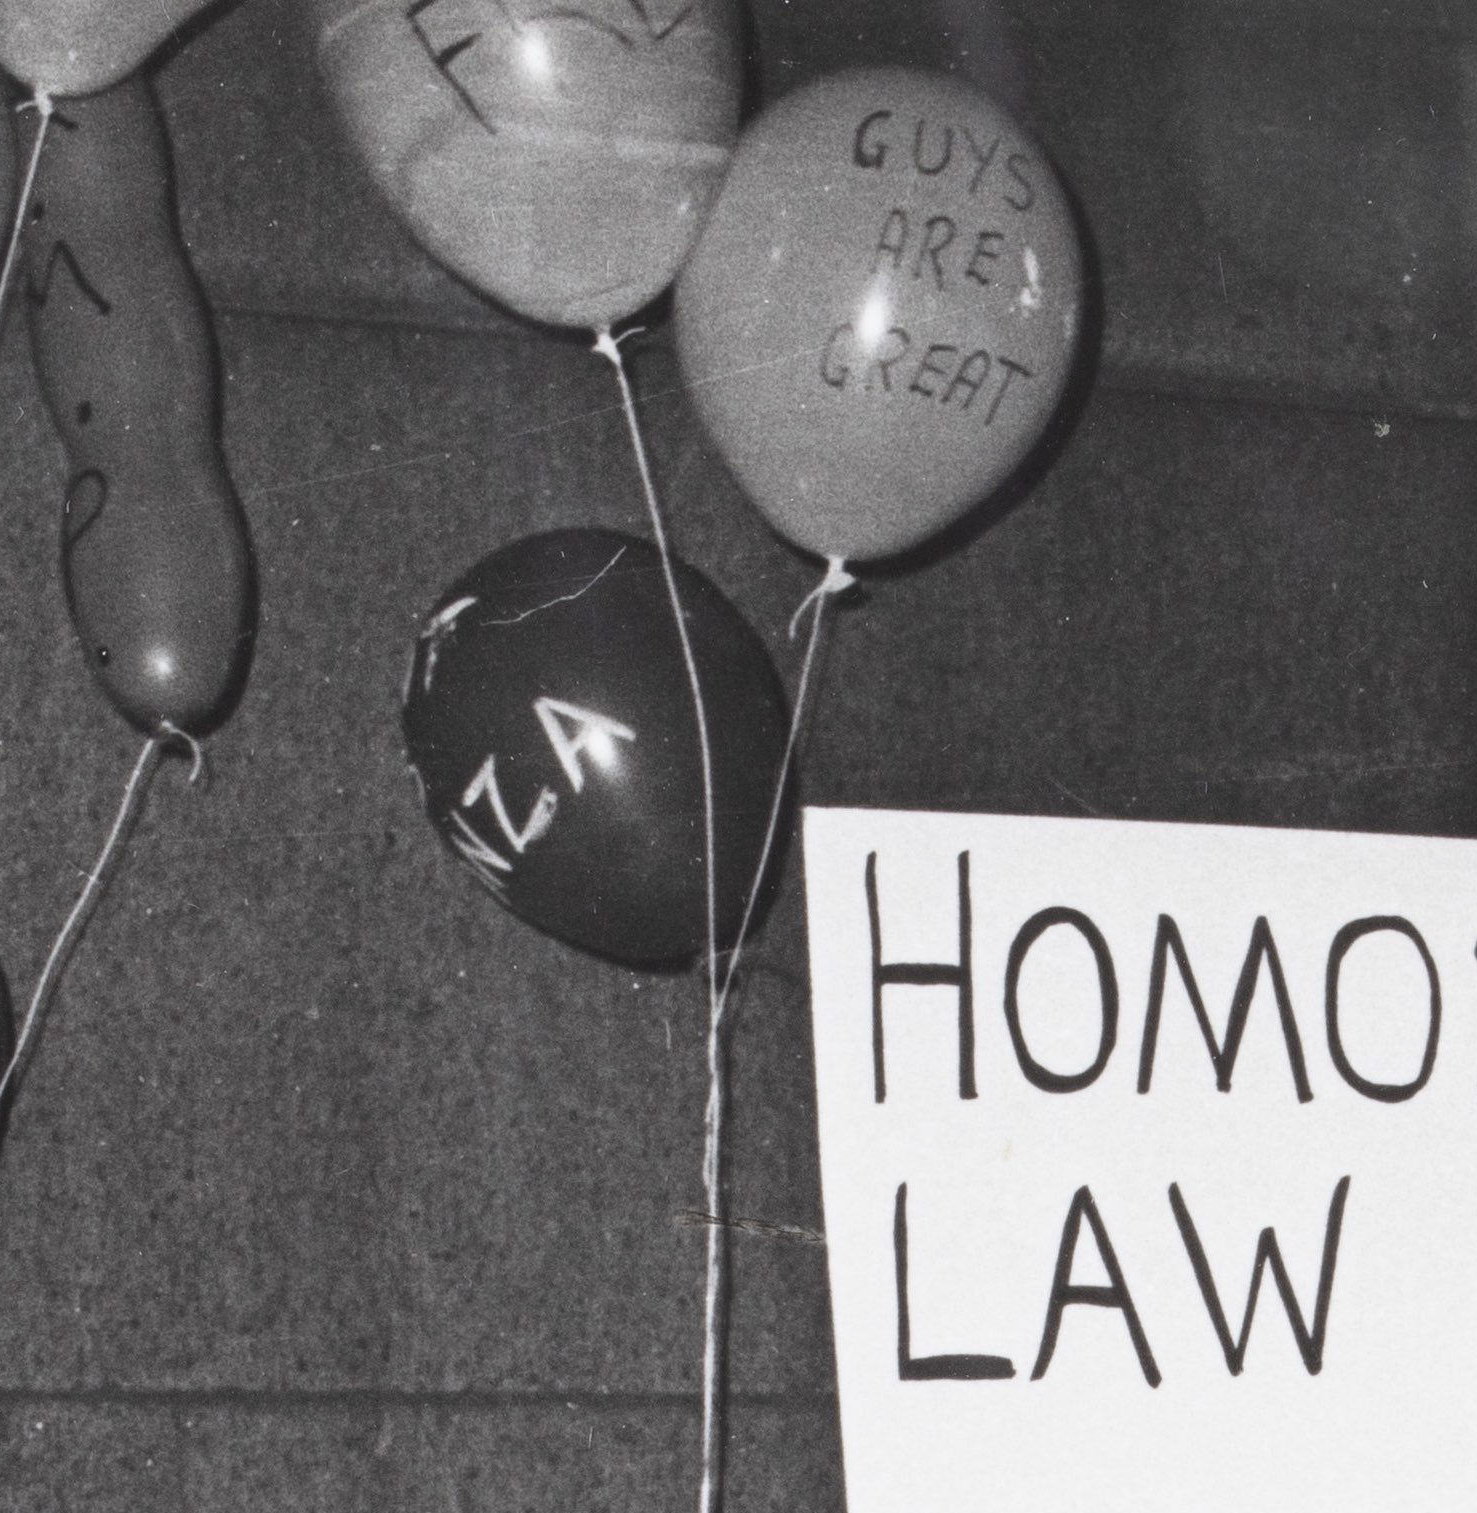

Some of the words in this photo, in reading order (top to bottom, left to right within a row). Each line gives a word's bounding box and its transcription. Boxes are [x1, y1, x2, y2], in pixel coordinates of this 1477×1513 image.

[852, 108, 1038, 213] GUYS
[870, 206, 1007, 293] ARE
[818, 318, 1034, 428] GREAT
[891, 1174, 1352, 1390] LAW
